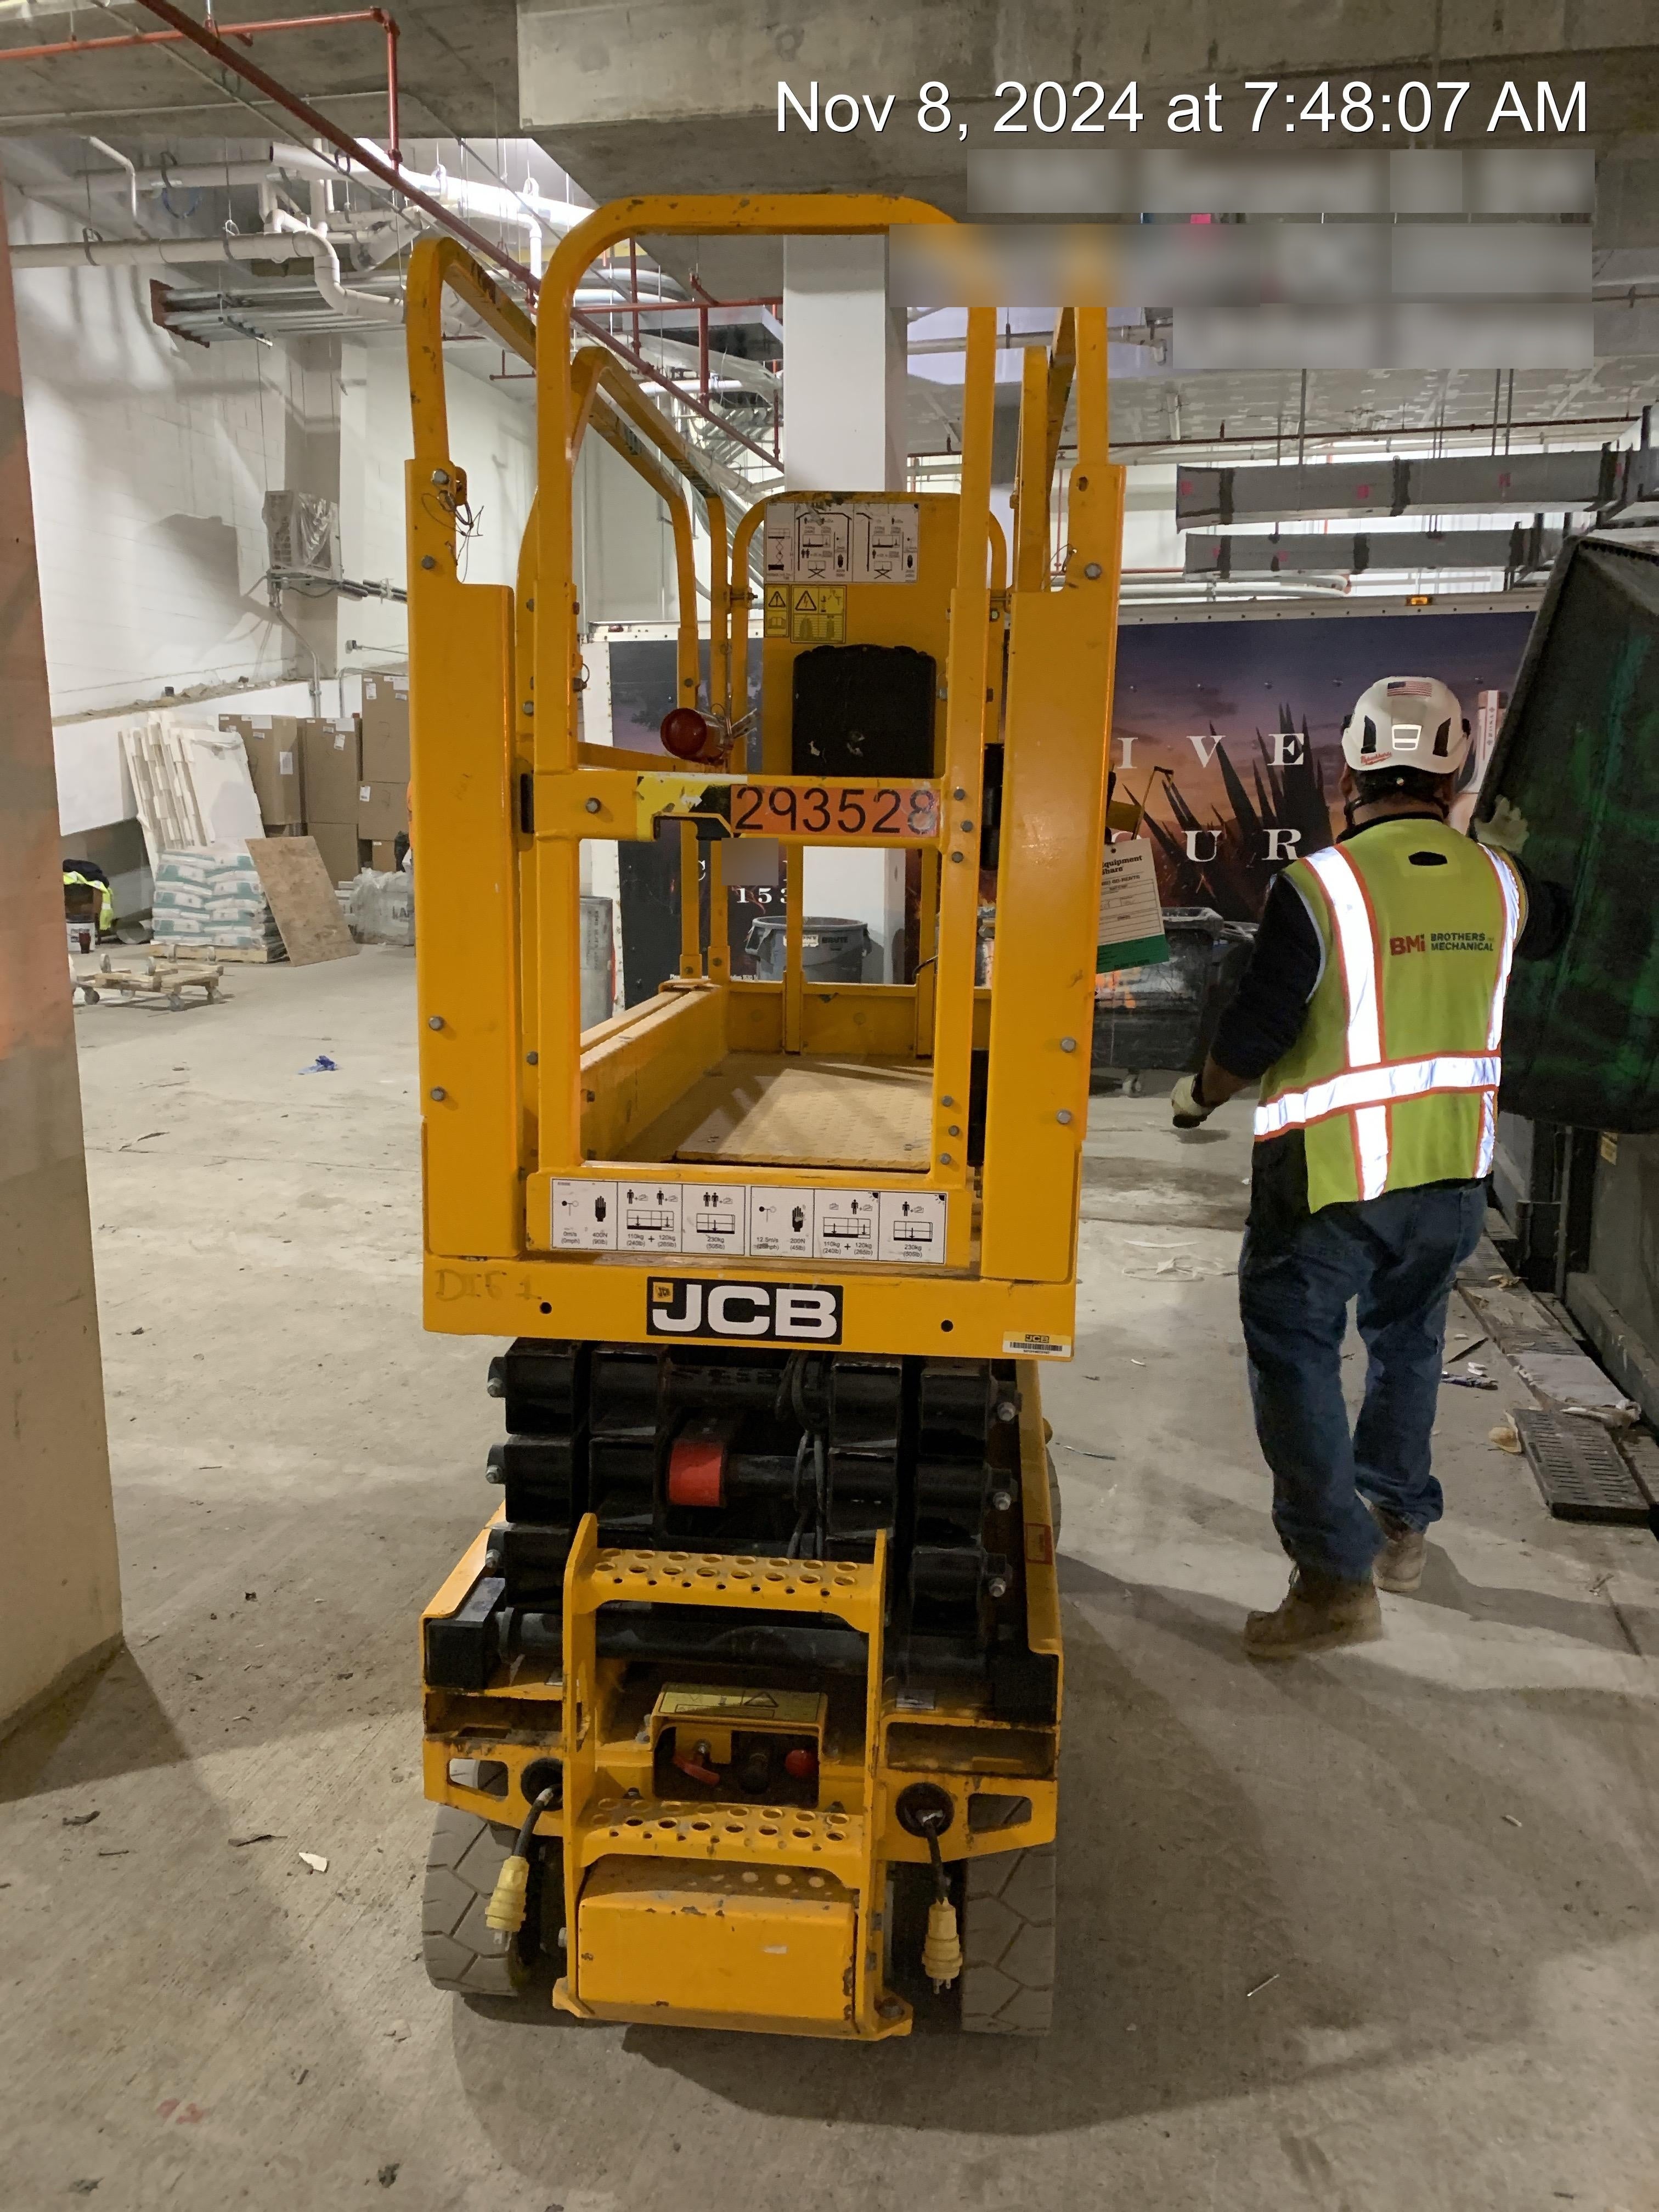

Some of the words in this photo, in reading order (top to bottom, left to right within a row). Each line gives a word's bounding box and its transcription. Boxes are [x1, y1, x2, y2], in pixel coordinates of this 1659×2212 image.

[735, 786, 935, 834] 293528
[1430, 933, 1486, 942] BROTHERS
[1430, 941, 1494, 952] MECHANICAL
[652, 1284, 837, 1338] JCB
[1025, 1334, 1049, 1343] JCB
